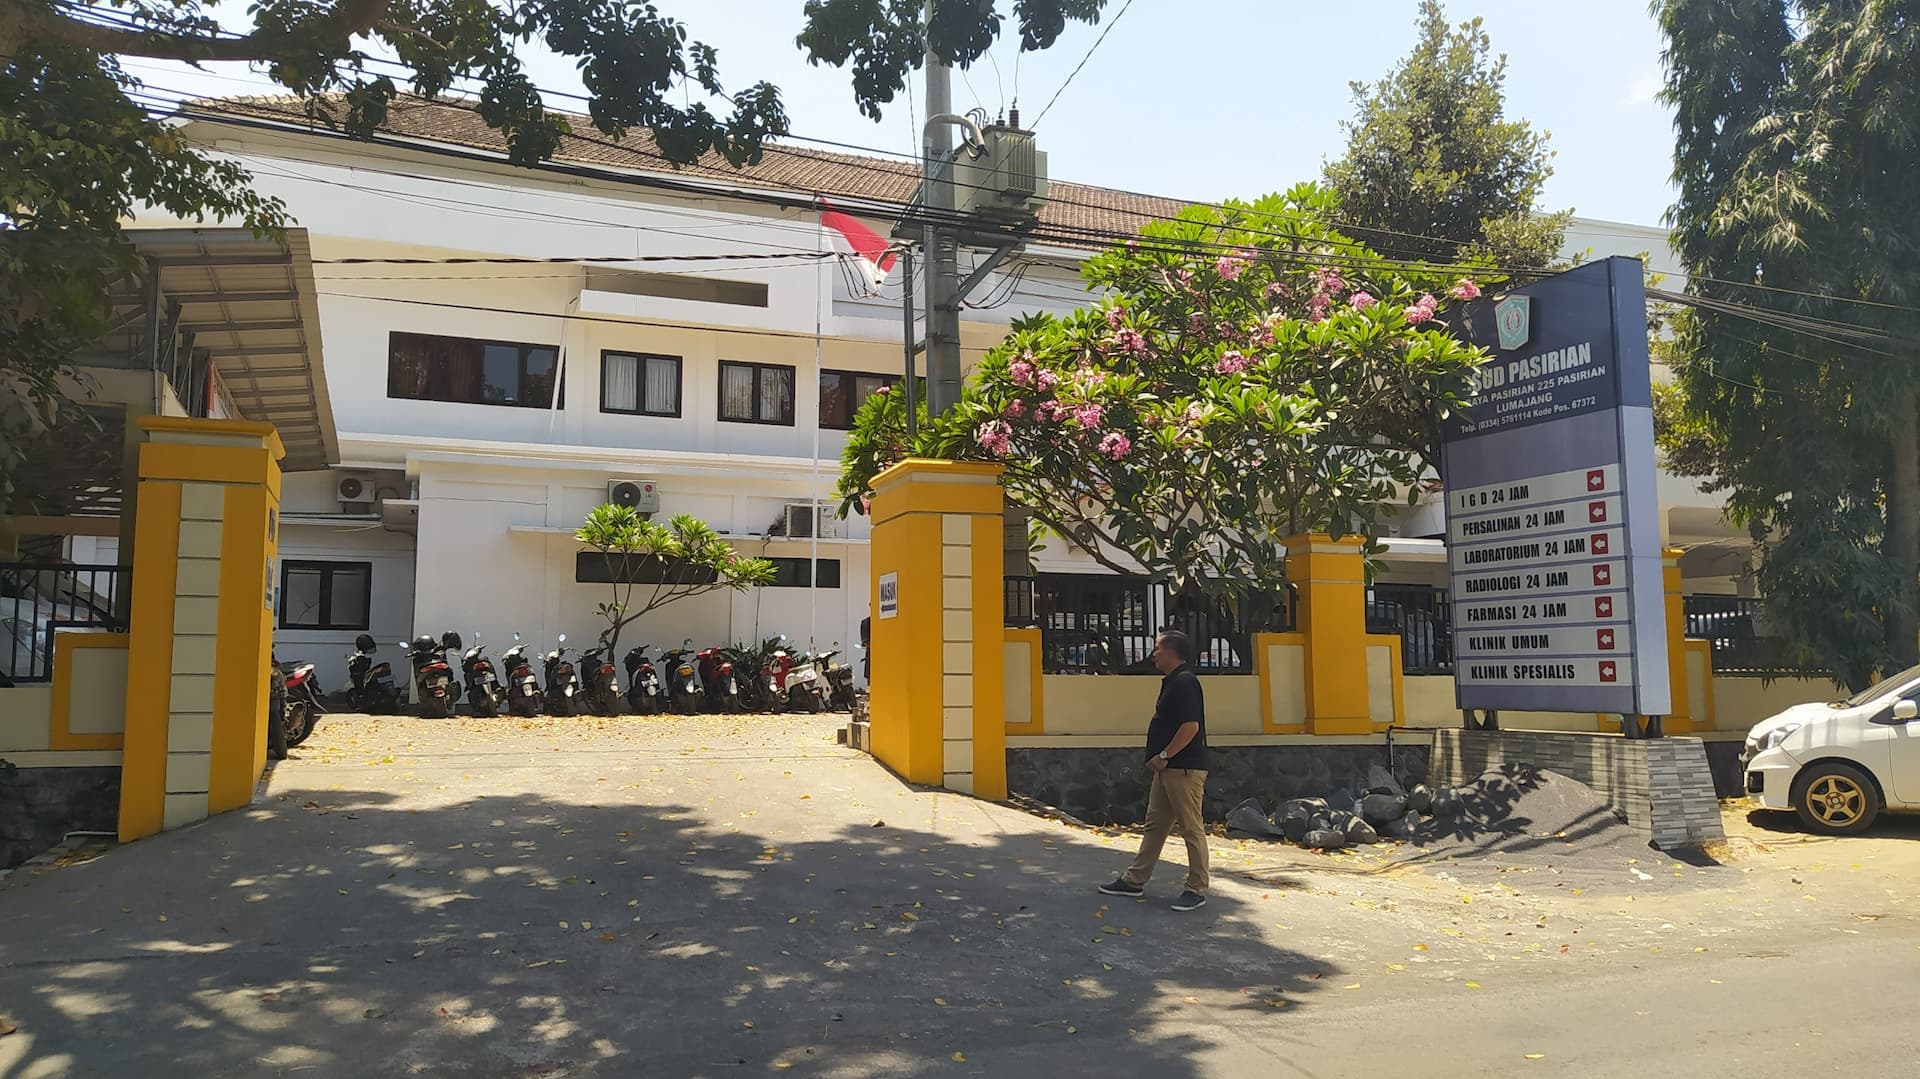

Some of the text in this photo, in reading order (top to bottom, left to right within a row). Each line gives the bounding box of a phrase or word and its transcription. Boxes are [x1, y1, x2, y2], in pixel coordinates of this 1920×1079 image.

[1509, 342, 1591, 383] PASIRIAN
[1491, 383, 1535, 402] PASIRIAN
[1537, 379, 1555, 391] 225
[1557, 365, 1606, 386] PASIRIAN
[1496, 392, 1553, 413] LUMAJANG
[1460, 423, 1477, 434] Telp.
[1533, 406, 1553, 418] Kode
[1554, 403, 1571, 413] Pos.
[1571, 395, 1596, 409] 67372
[1492, 488, 1504, 504] 24
[1508, 485, 1529, 501] JAM
[1462, 509, 1565, 537] PERSALINAN 24 JAM
[1464, 538, 1585, 565] LABORATORIUM 24 JAM
[1465, 571, 1568, 593] RADIOLOGI 24 JAM
[1467, 603, 1567, 622] FARMASI 24 JAM
[1469, 634, 1549, 651] KLINIK UMUM
[1471, 664, 1575, 680] KLINIK SPESIALIS
